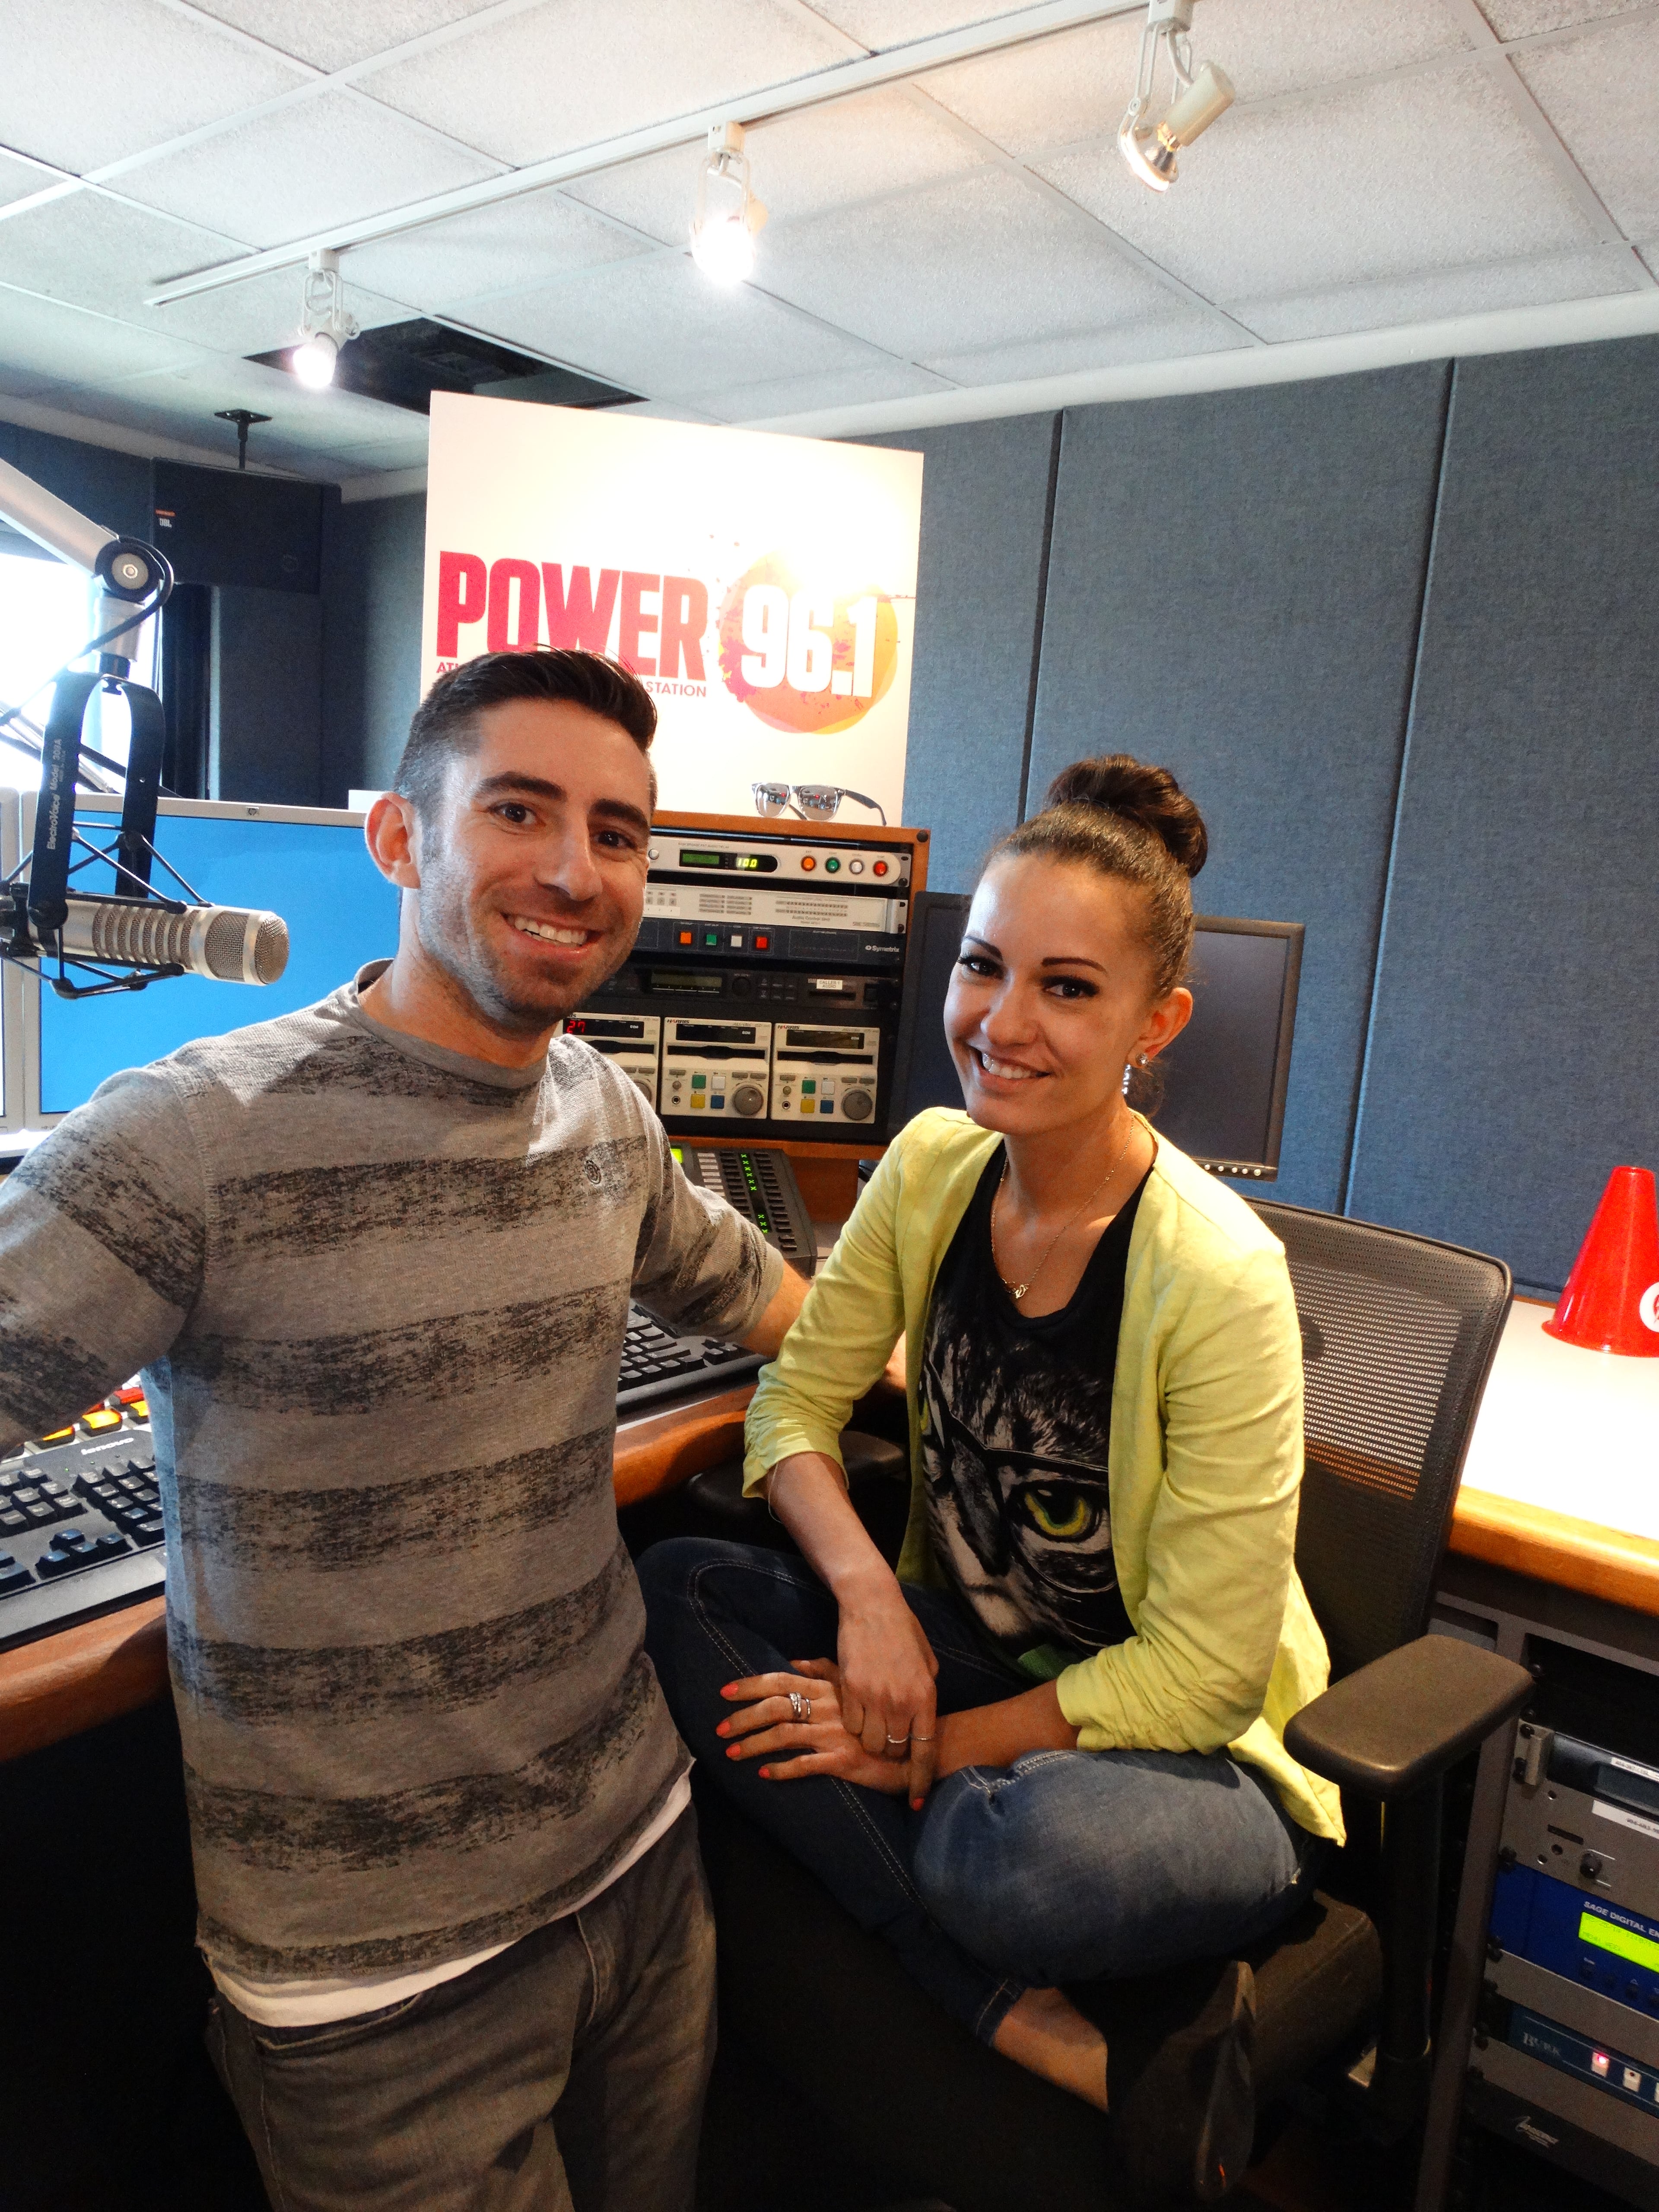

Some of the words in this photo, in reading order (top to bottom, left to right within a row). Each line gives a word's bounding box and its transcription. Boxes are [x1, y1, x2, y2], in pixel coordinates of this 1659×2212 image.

[436, 550, 707, 681] POWER
[741, 584, 877, 698] 96.1
[645, 681, 707, 698] STATION
[49, 764, 60, 791] Model
[566, 1020, 586, 1034] 27
[81, 1437, 134, 1456] lenovo
[1583, 1901, 1609, 1916] SAGE
[1610, 1911, 1646, 1932] DIGITAL
